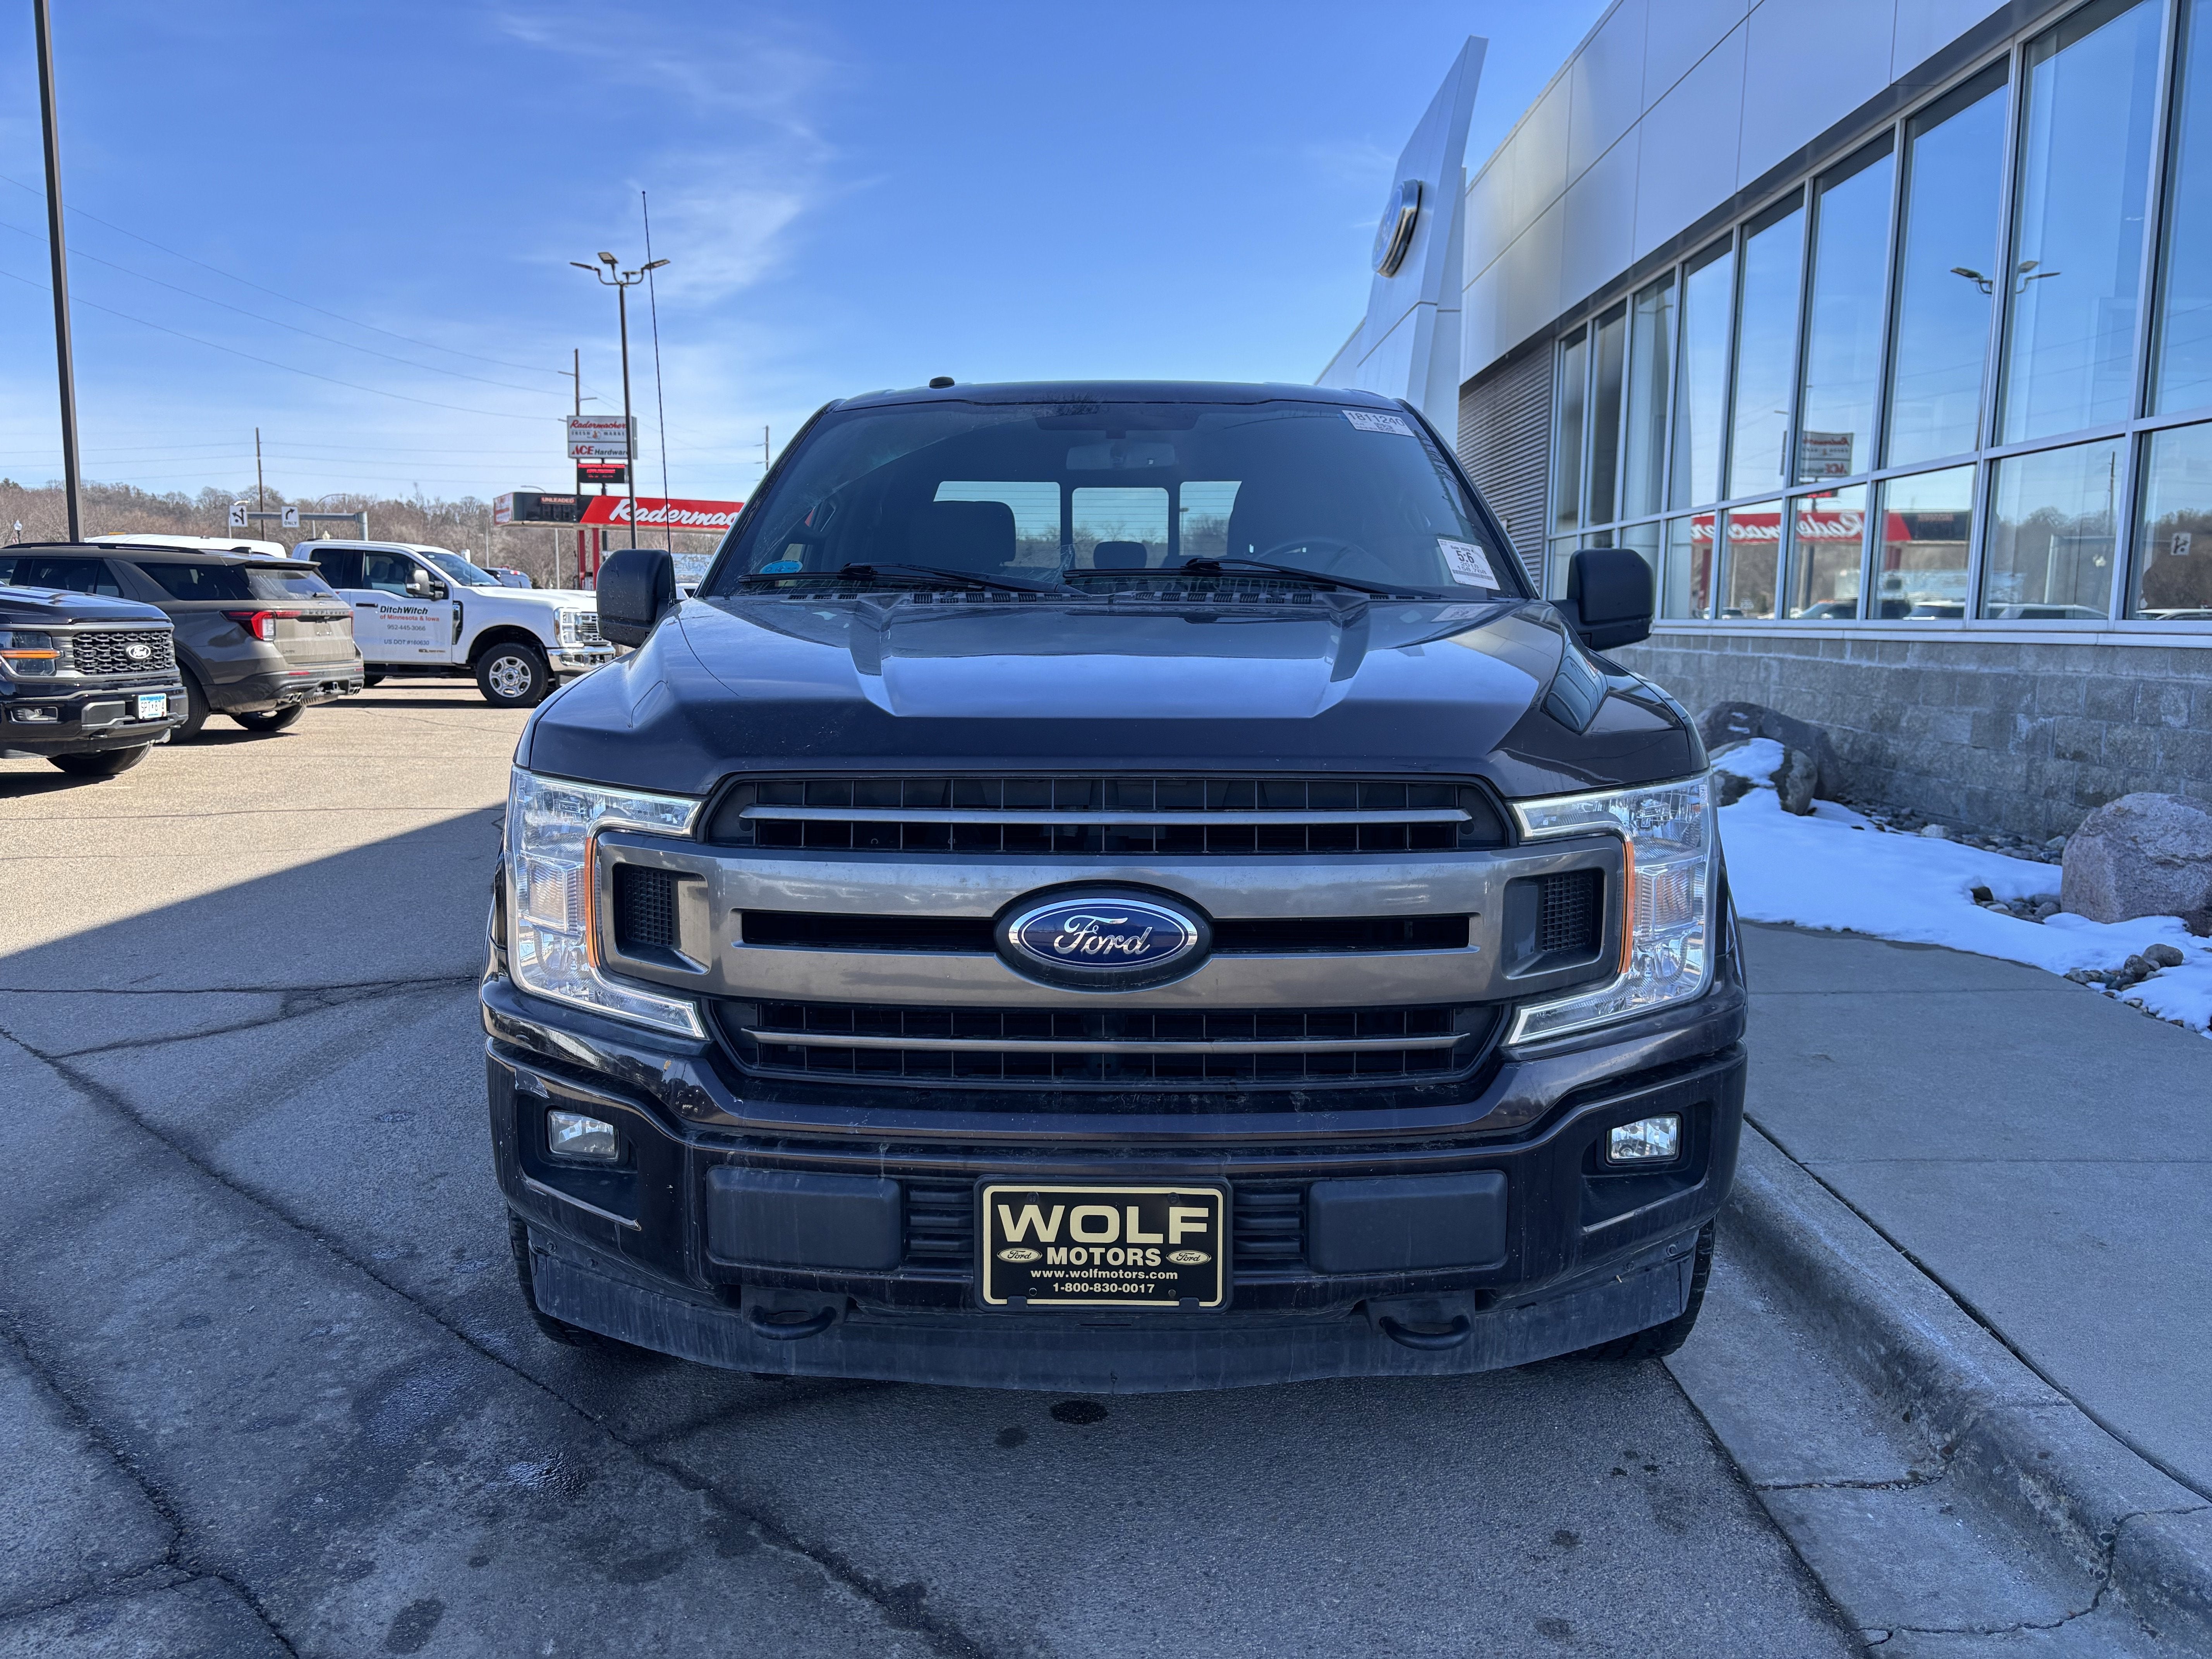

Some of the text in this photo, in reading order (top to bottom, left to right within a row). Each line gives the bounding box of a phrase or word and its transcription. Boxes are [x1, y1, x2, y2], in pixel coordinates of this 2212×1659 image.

[570, 419, 627, 429] Radermacher
[1348, 412, 1405, 426] 1811240
[572, 445, 594, 455] ACE
[1054, 915, 1153, 954] Ford
[997, 1204, 1209, 1244] WOLF
[1007, 1250, 1032, 1260] Ford
[1047, 1247, 1161, 1266] MOTORS
[1175, 1252, 1201, 1262] Ford
[1030, 1269, 1178, 1279] www.wolfmotors.com
[1053, 1283, 1155, 1294] 1-800-830-0017
